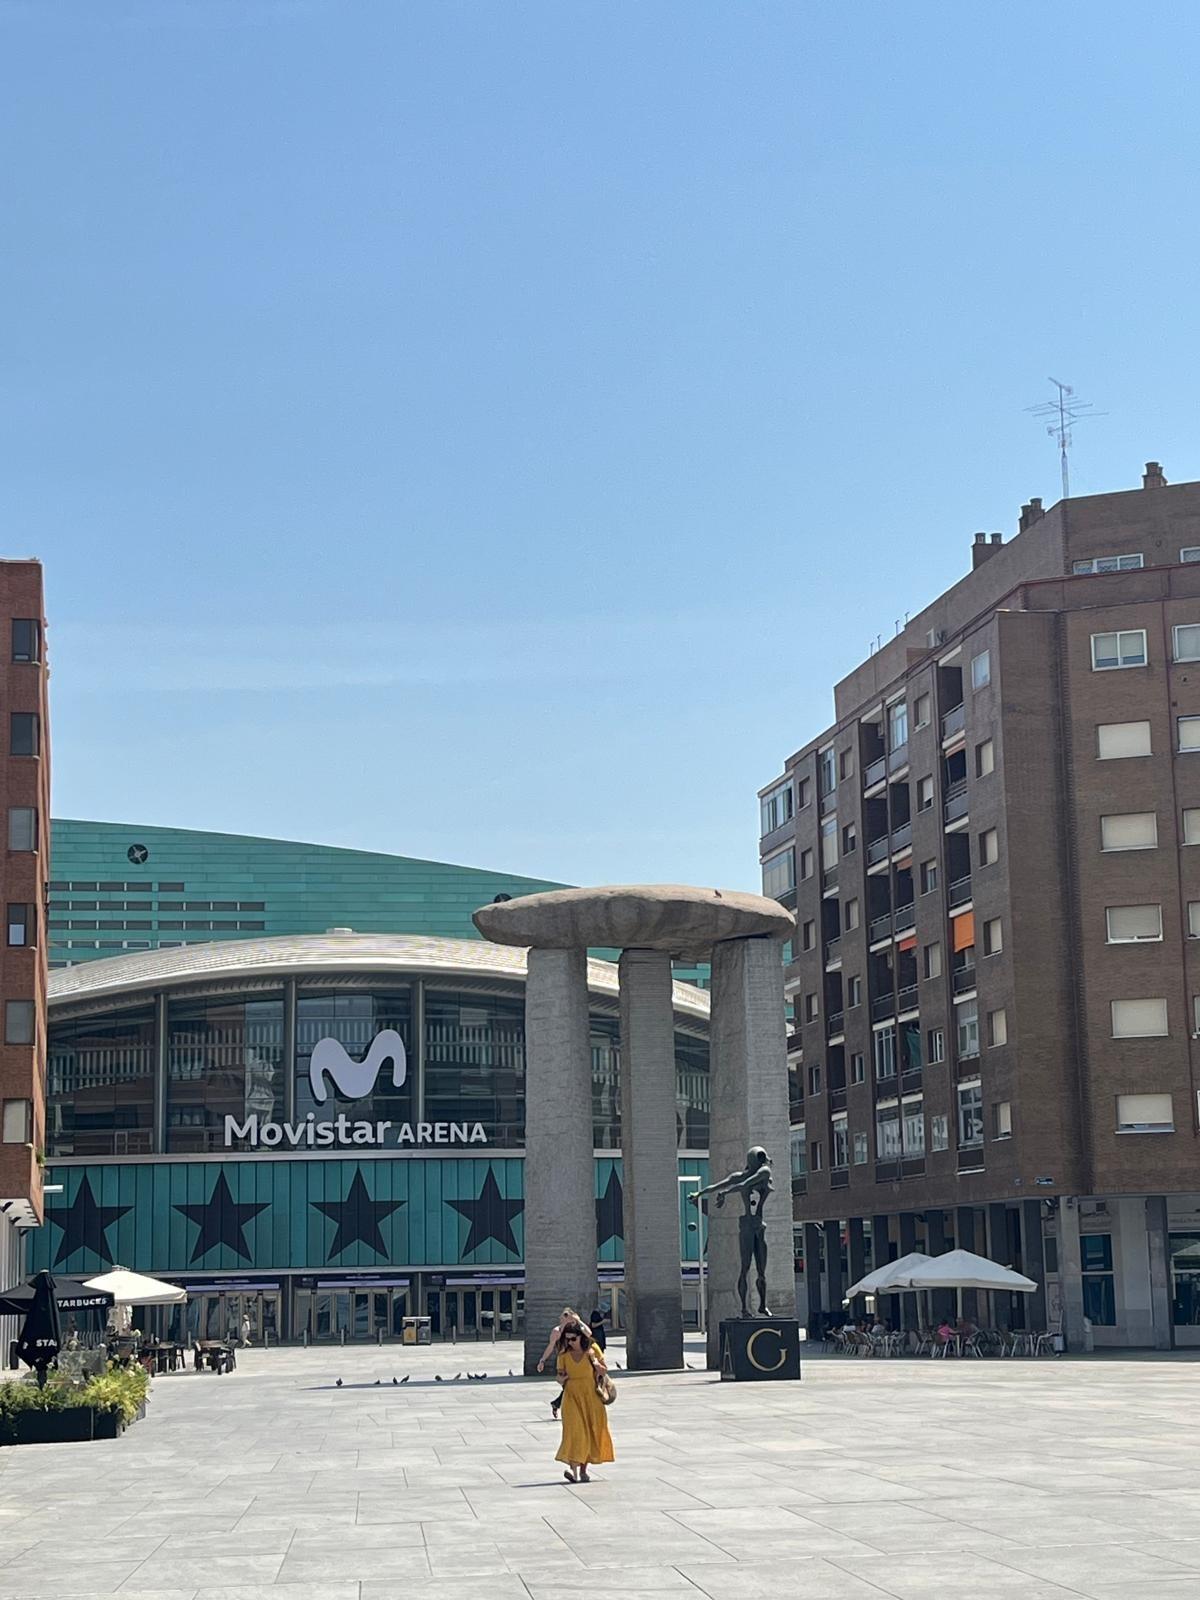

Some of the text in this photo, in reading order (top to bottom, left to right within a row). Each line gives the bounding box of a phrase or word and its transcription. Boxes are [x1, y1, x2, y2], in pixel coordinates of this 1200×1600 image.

[224, 1112, 488, 1146] Movistar ARENA
[57, 1297, 107, 1308] TARBUCKS
[747, 1328, 787, 1371] G
